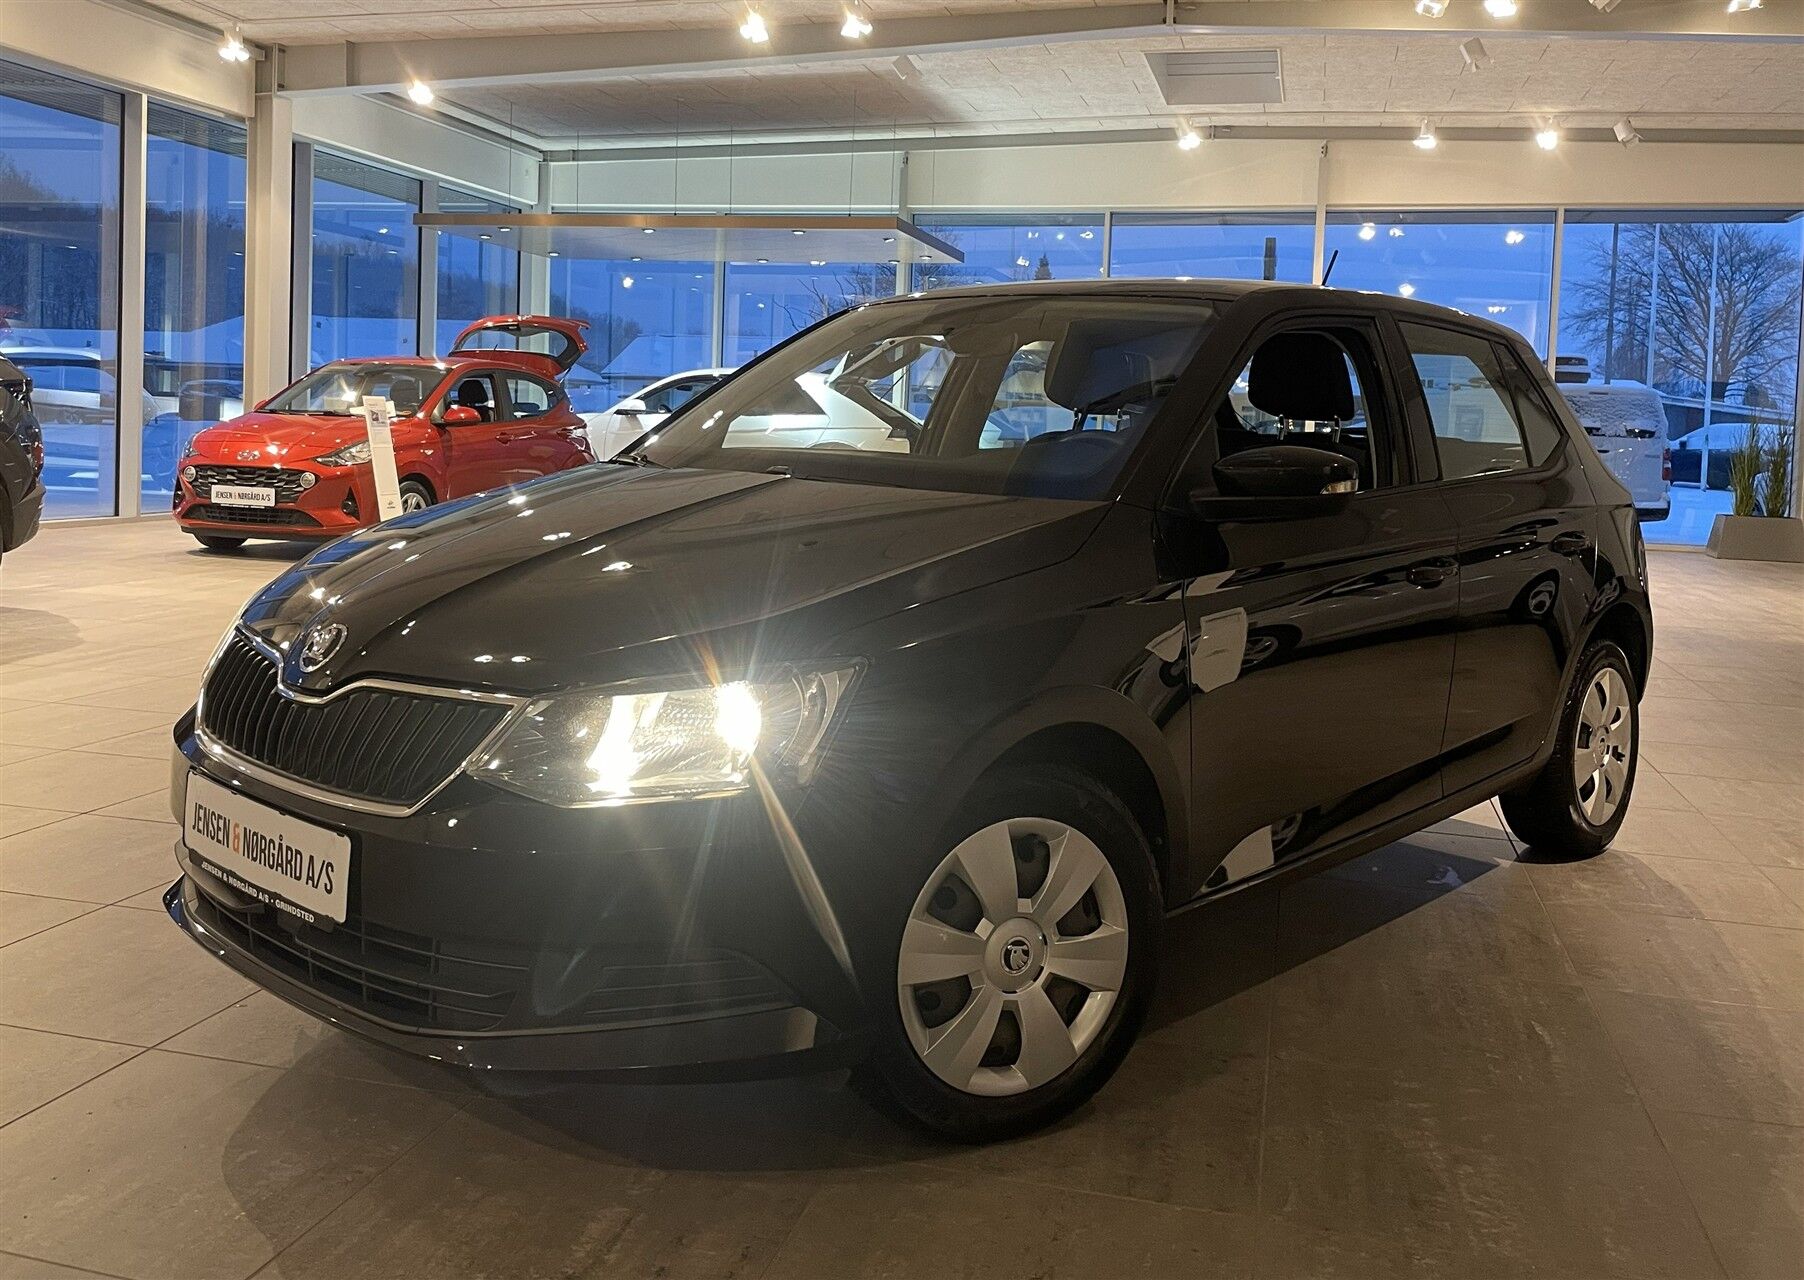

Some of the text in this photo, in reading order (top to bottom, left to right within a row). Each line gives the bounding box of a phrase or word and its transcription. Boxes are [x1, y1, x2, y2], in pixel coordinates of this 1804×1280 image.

[192, 802, 335, 895] JENSEN & NØRGÅRD A/S
[201, 861, 222, 877] JENSEN
[223, 867, 229, 881] &
[258, 891, 269, 903] A/S
[275, 899, 315, 923] GRINDSTED
